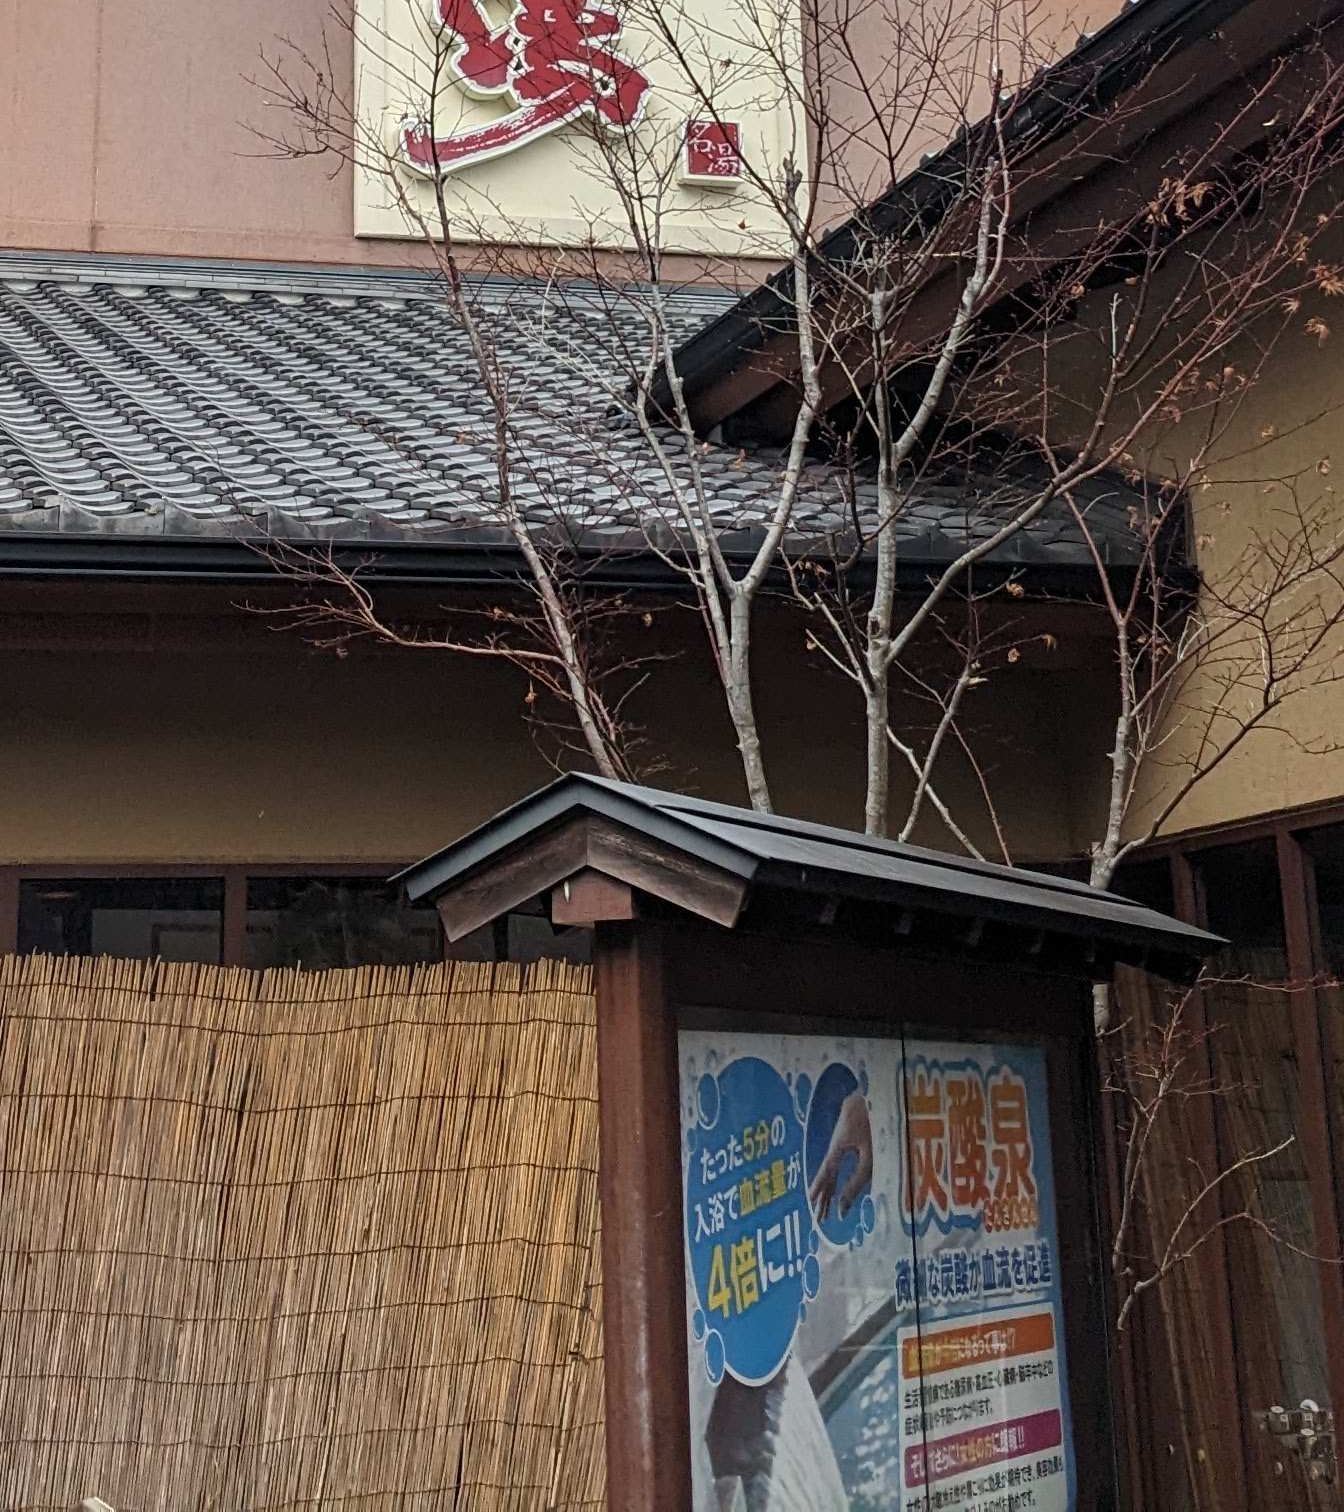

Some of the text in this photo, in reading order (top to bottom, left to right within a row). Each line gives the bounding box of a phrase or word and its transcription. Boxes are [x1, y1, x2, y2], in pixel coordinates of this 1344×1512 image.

[701, 1115, 785, 1184] たった5分の
[903, 1068, 1038, 1216] 炭酸泉
[695, 1152, 801, 1242] 入浴で血流量が
[708, 1210, 802, 1318] 4倍に!!
